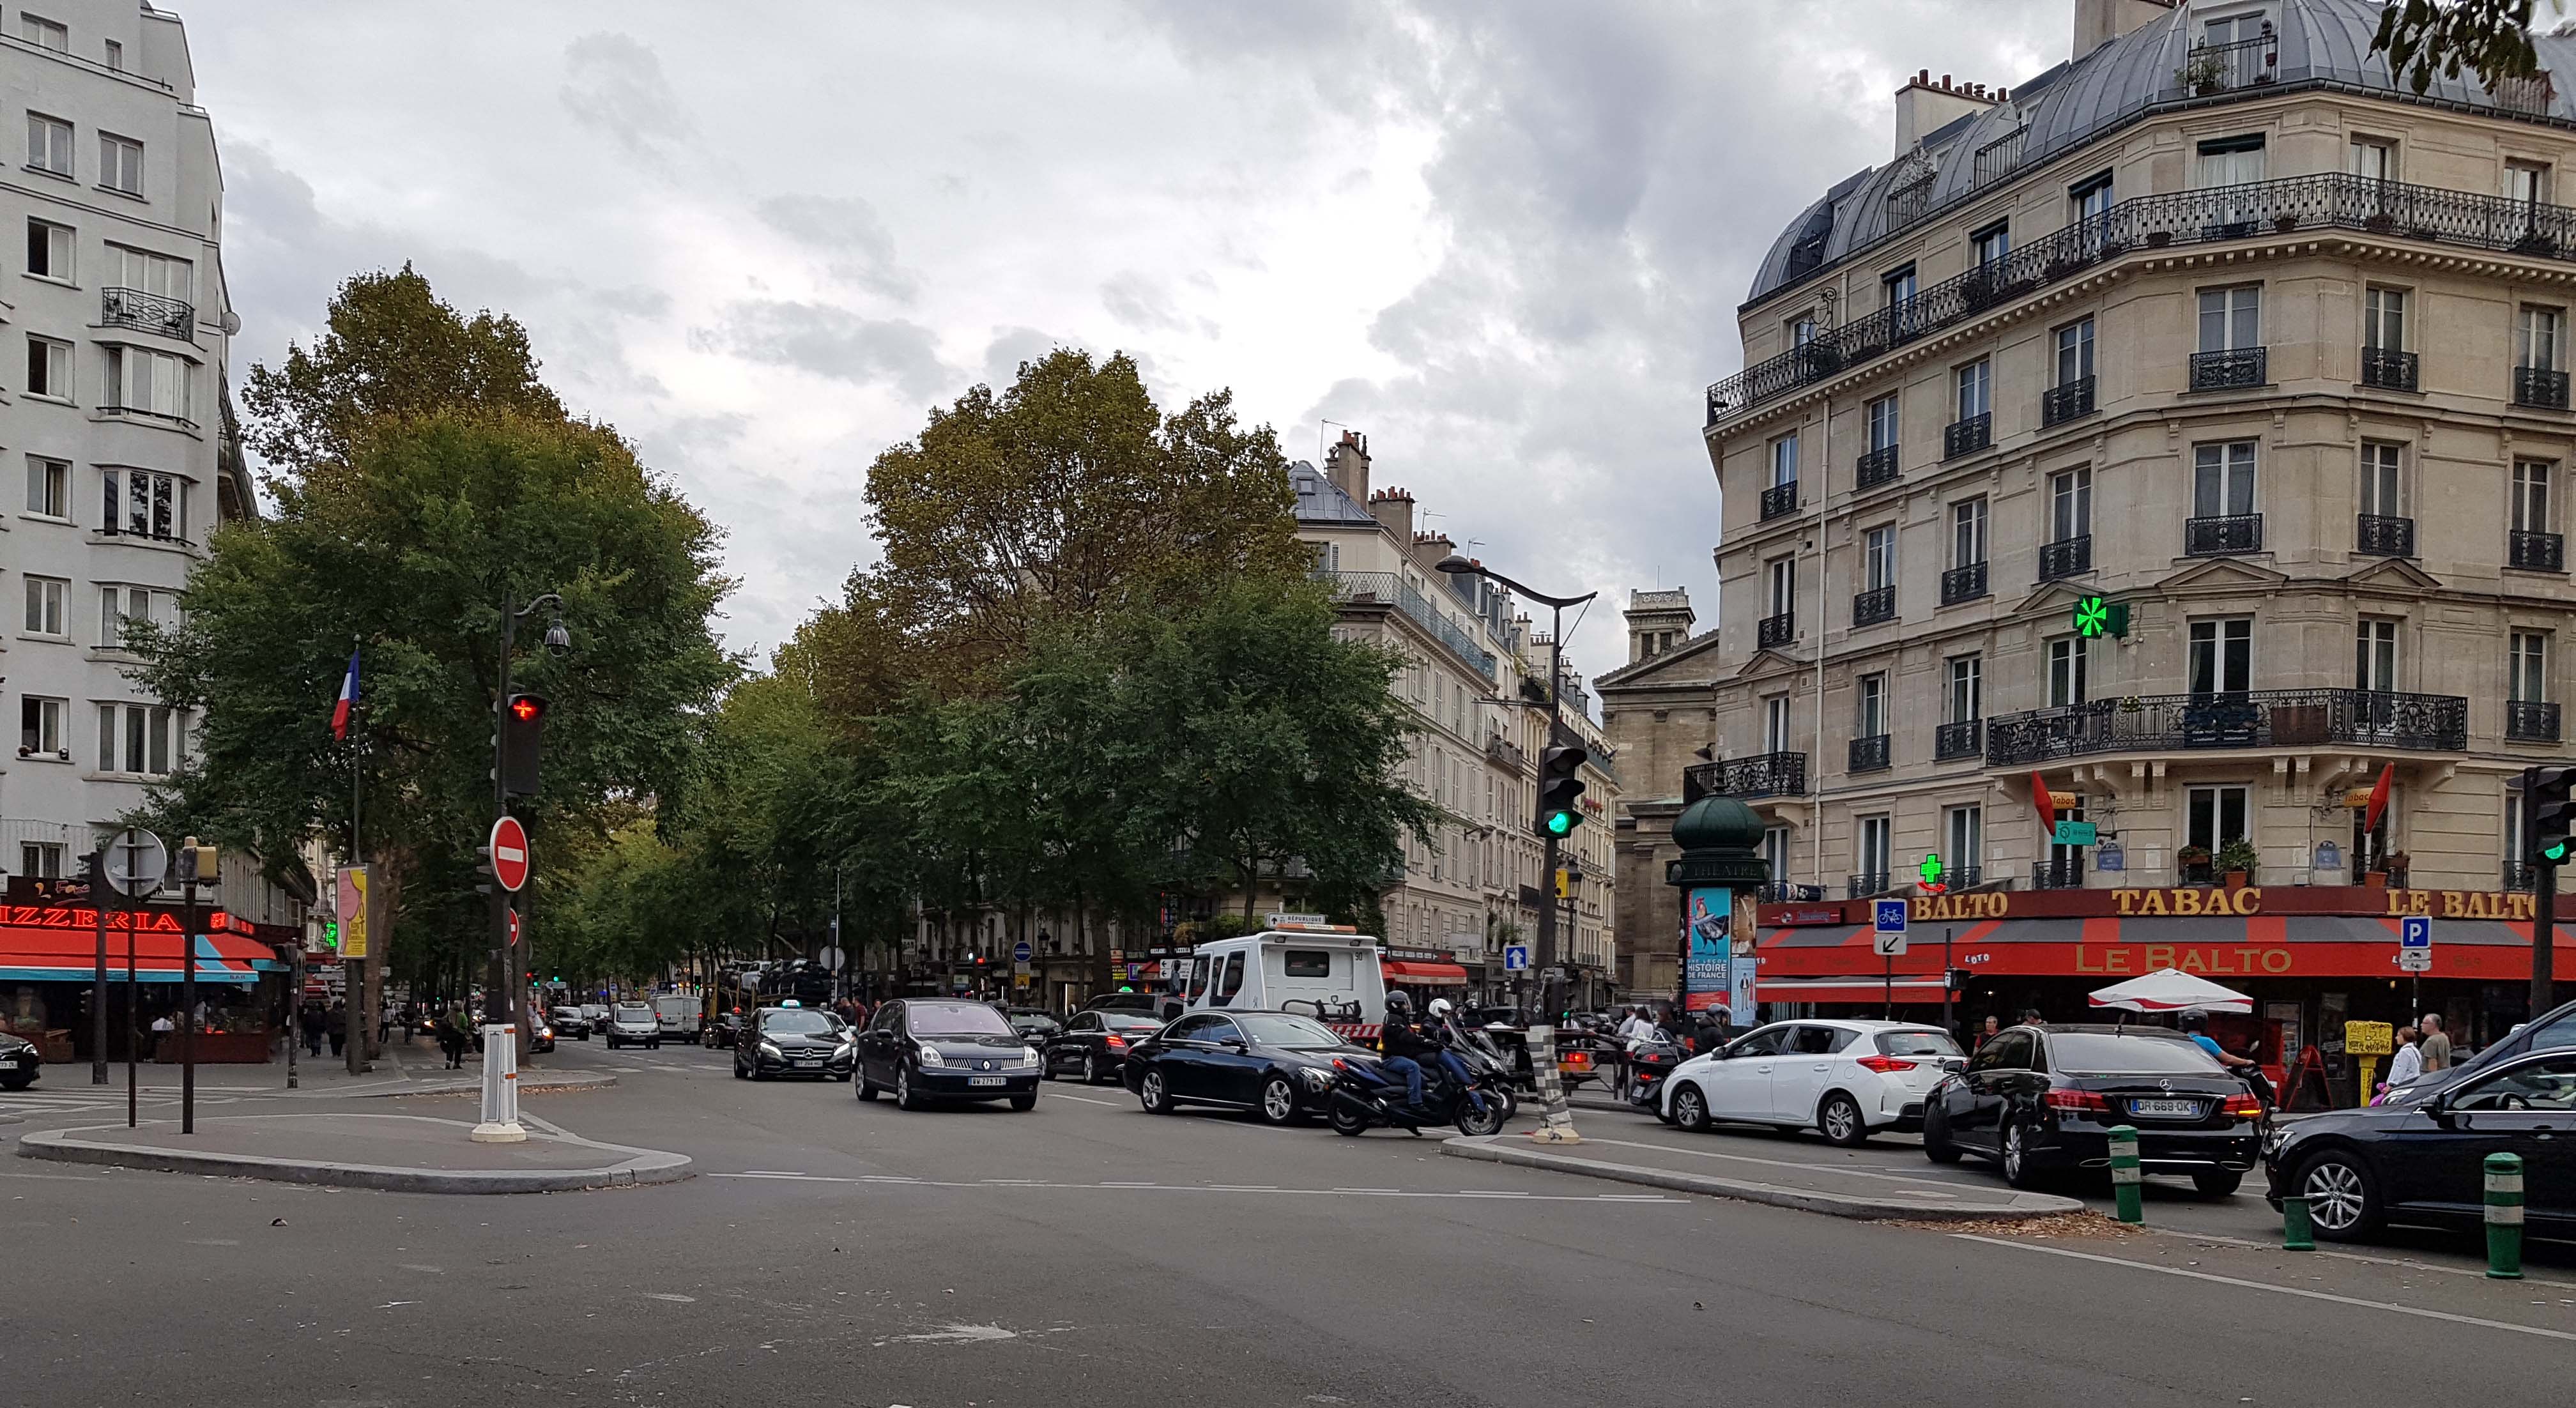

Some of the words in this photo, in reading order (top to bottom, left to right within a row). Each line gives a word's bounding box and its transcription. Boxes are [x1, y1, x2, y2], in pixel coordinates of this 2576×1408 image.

[2052, 795, 2074, 805] Tabac
[1913, 892, 2008, 921] BALTO
[2112, 888, 2261, 915] TABAC
[2386, 889, 2430, 915] LE
[0, 907, 182, 931] IZZERIA
[2409, 924, 2422, 942] P
[1355, 952, 1363, 961] 90
[1965, 954, 1990, 964] LOTO
[2075, 944, 2131, 973] LE
[2145, 944, 2292, 973] BALTO
[1687, 963, 1727, 972] HISTOIRE
